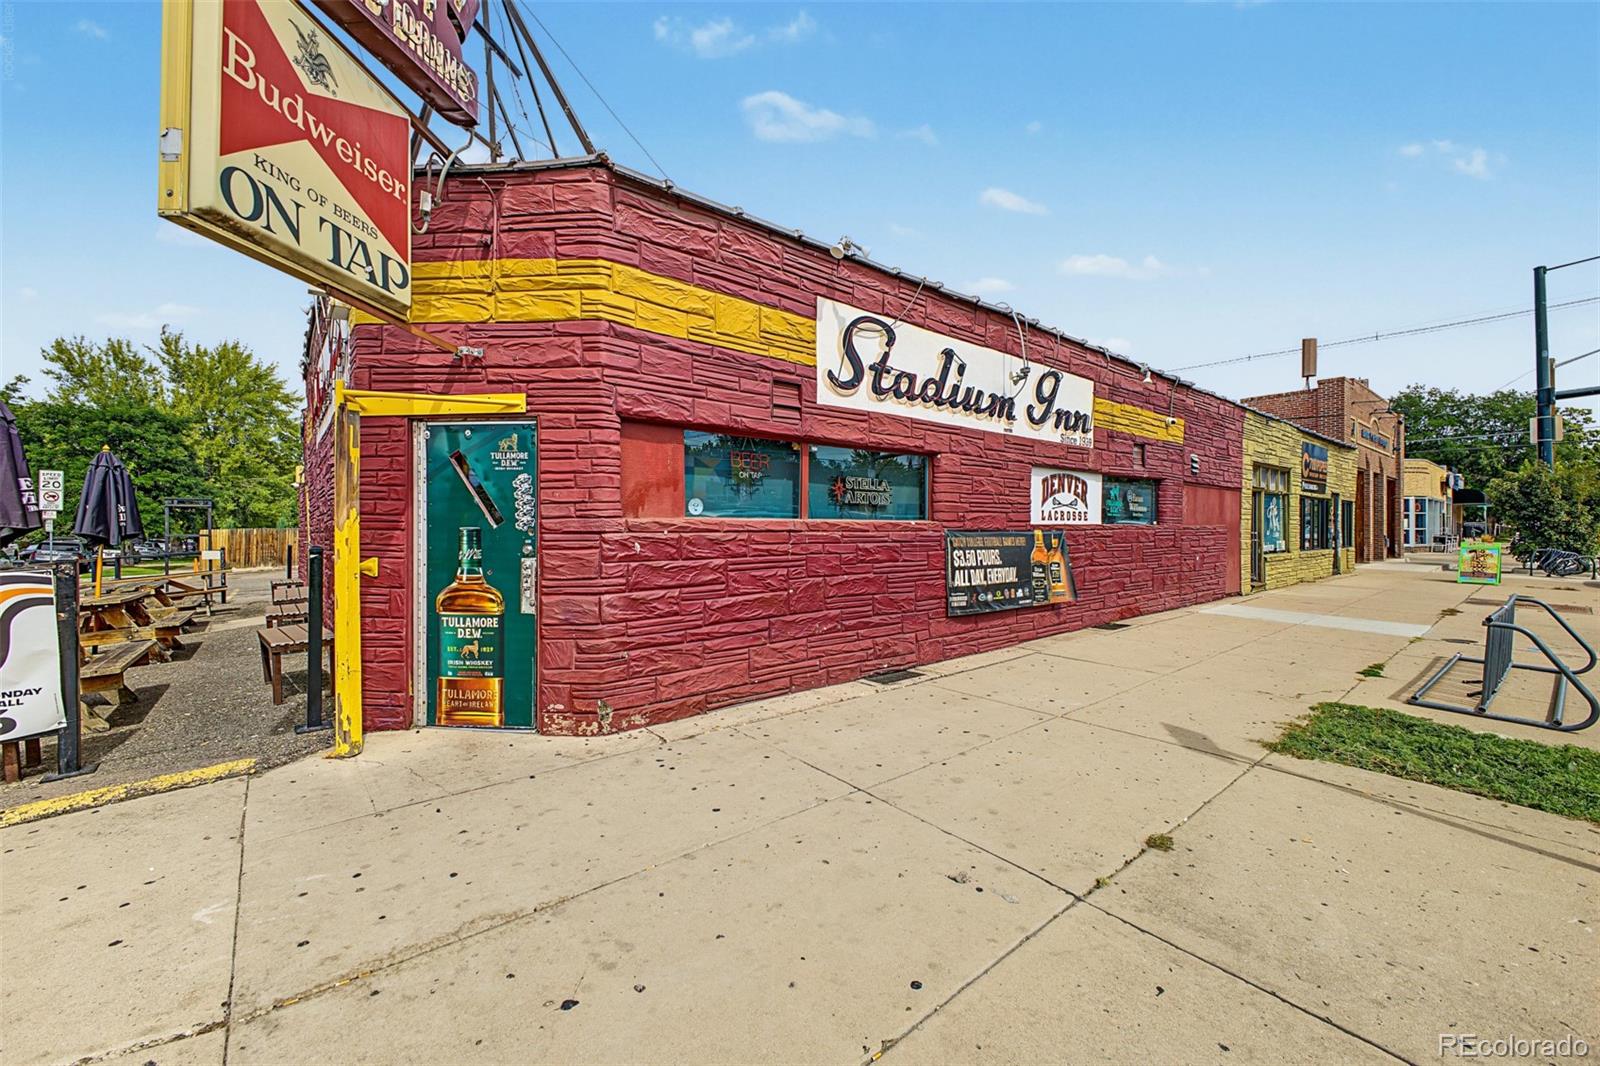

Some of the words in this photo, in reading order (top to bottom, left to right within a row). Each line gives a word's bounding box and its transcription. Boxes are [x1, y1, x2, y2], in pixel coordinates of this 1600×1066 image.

[253, 153, 301, 192] KING
[307, 188, 328, 206] OF
[333, 203, 378, 240] BEERS
[219, 166, 305, 246] ON
[319, 215, 409, 296] TAP
[826, 314, 1017, 422] Stadium
[1026, 368, 1092, 433] Inn
[1060, 433, 1078, 446] Since
[731, 451, 769, 470] BEER
[750, 471, 763, 479] TAP
[42, 480, 61, 489] 20
[845, 476, 890, 492] STELLA
[1041, 473, 1089, 511] DENVER
[845, 490, 891, 505] ARTOIS
[1041, 510, 1088, 521] LACROSSE
[953, 549, 977, 567] $3.50
[954, 569, 971, 587] ALL
[441, 616, 499, 628] TULLAMORE
